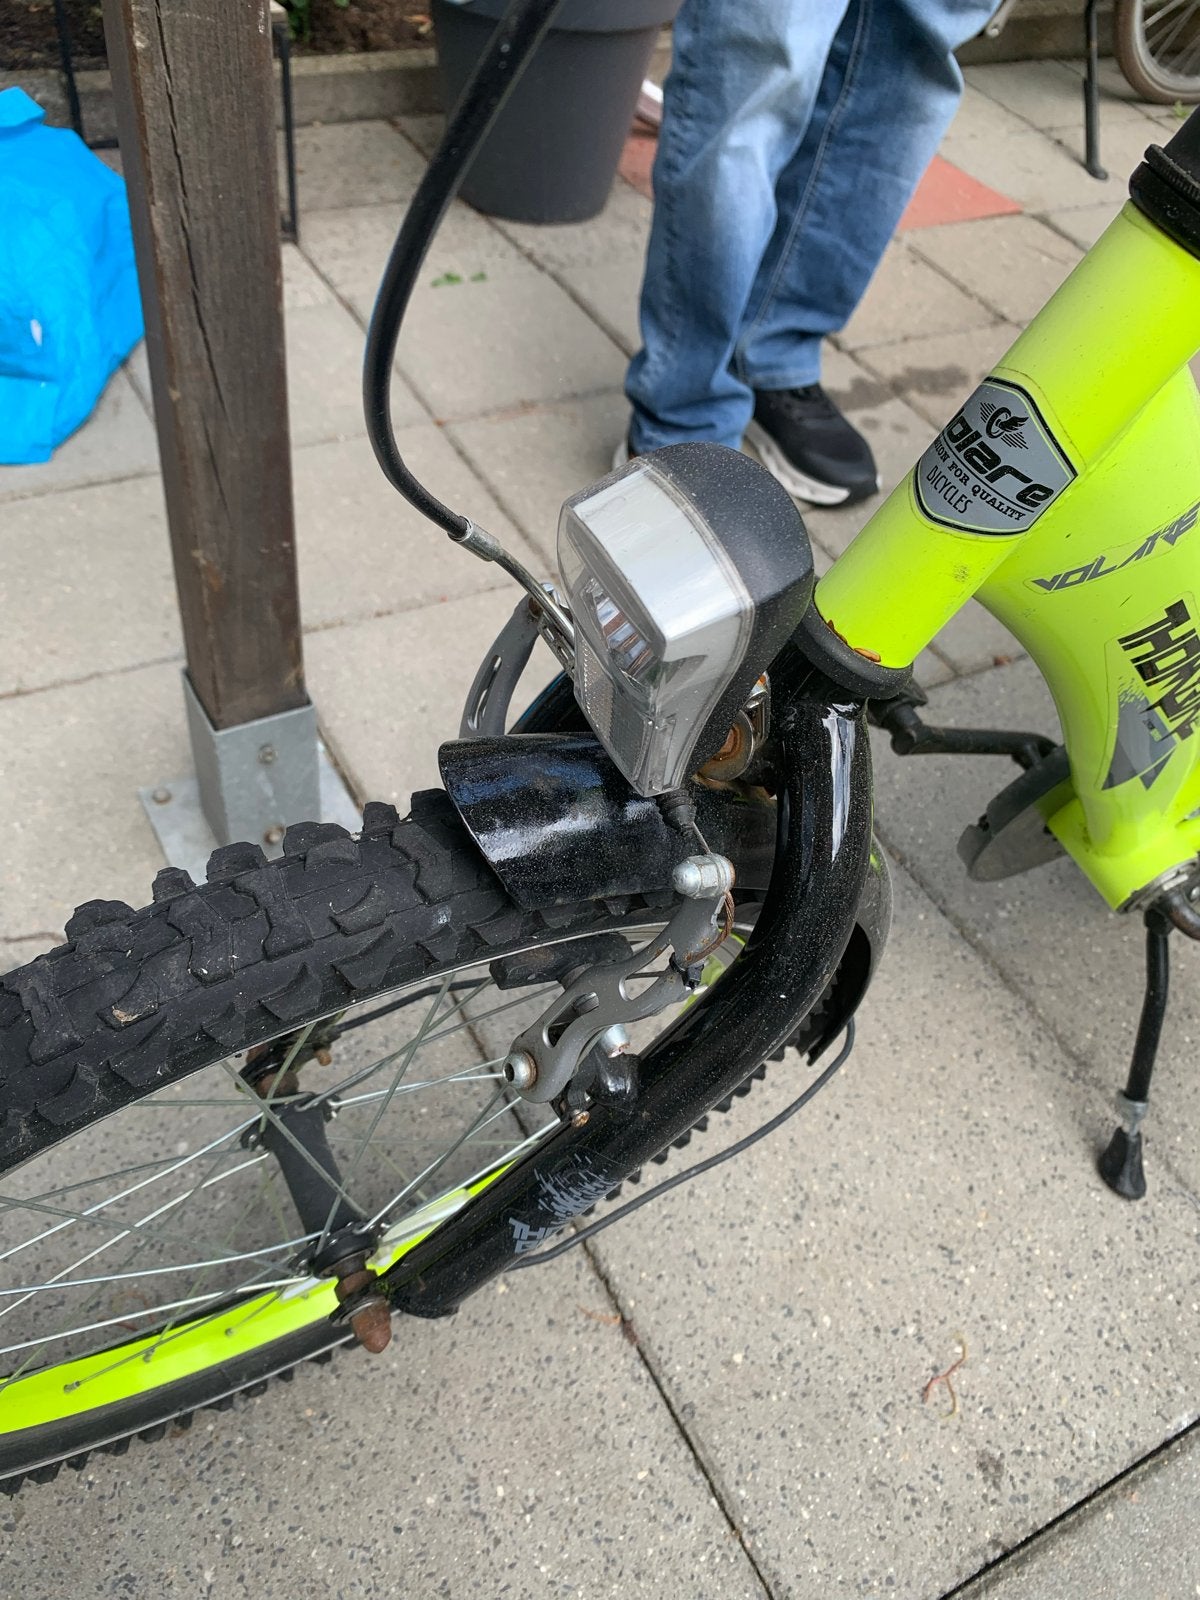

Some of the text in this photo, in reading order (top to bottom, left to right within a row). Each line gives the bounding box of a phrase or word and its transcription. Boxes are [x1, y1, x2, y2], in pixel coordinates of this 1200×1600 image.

[926, 464, 974, 514] BICYCLES
[945, 408, 1054, 508] olare
[947, 460, 970, 487] FOR
[971, 484, 1027, 522] QUALITY
